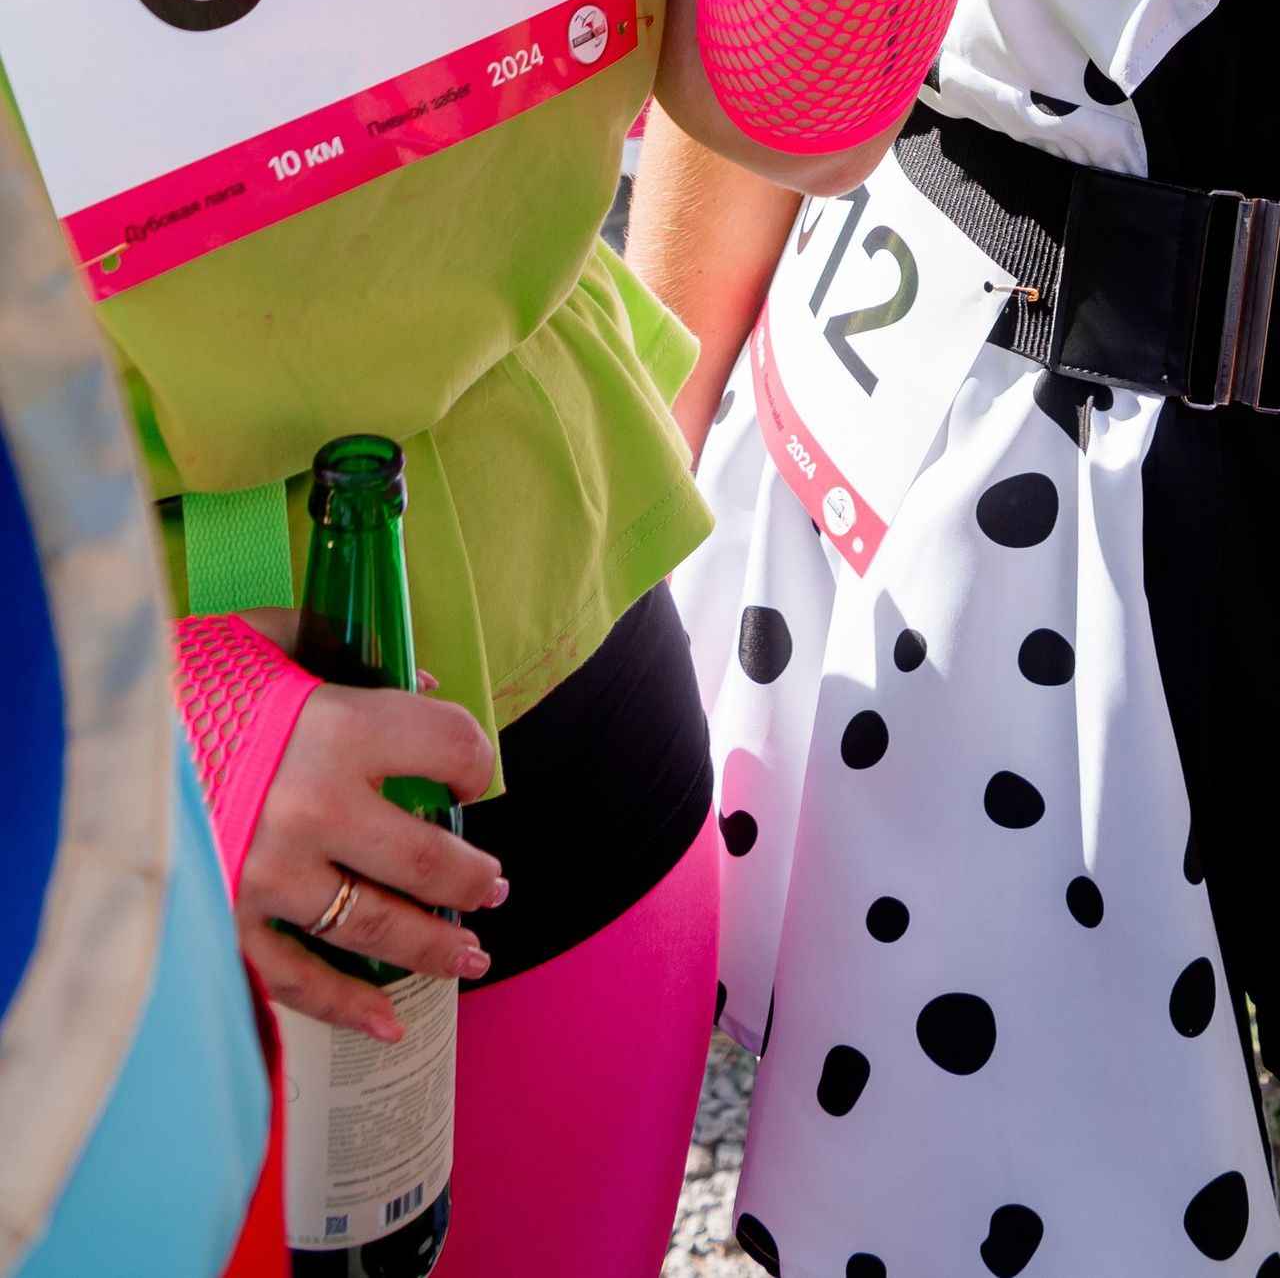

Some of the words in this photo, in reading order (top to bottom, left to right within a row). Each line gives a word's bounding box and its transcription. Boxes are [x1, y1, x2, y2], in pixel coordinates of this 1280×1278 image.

[124, 200, 201, 243] Дубовая
[204, 181, 246, 209] лапа
[268, 149, 301, 181] 10
[487, 43, 544, 88] 2024
[786, 434, 817, 480] 2024
